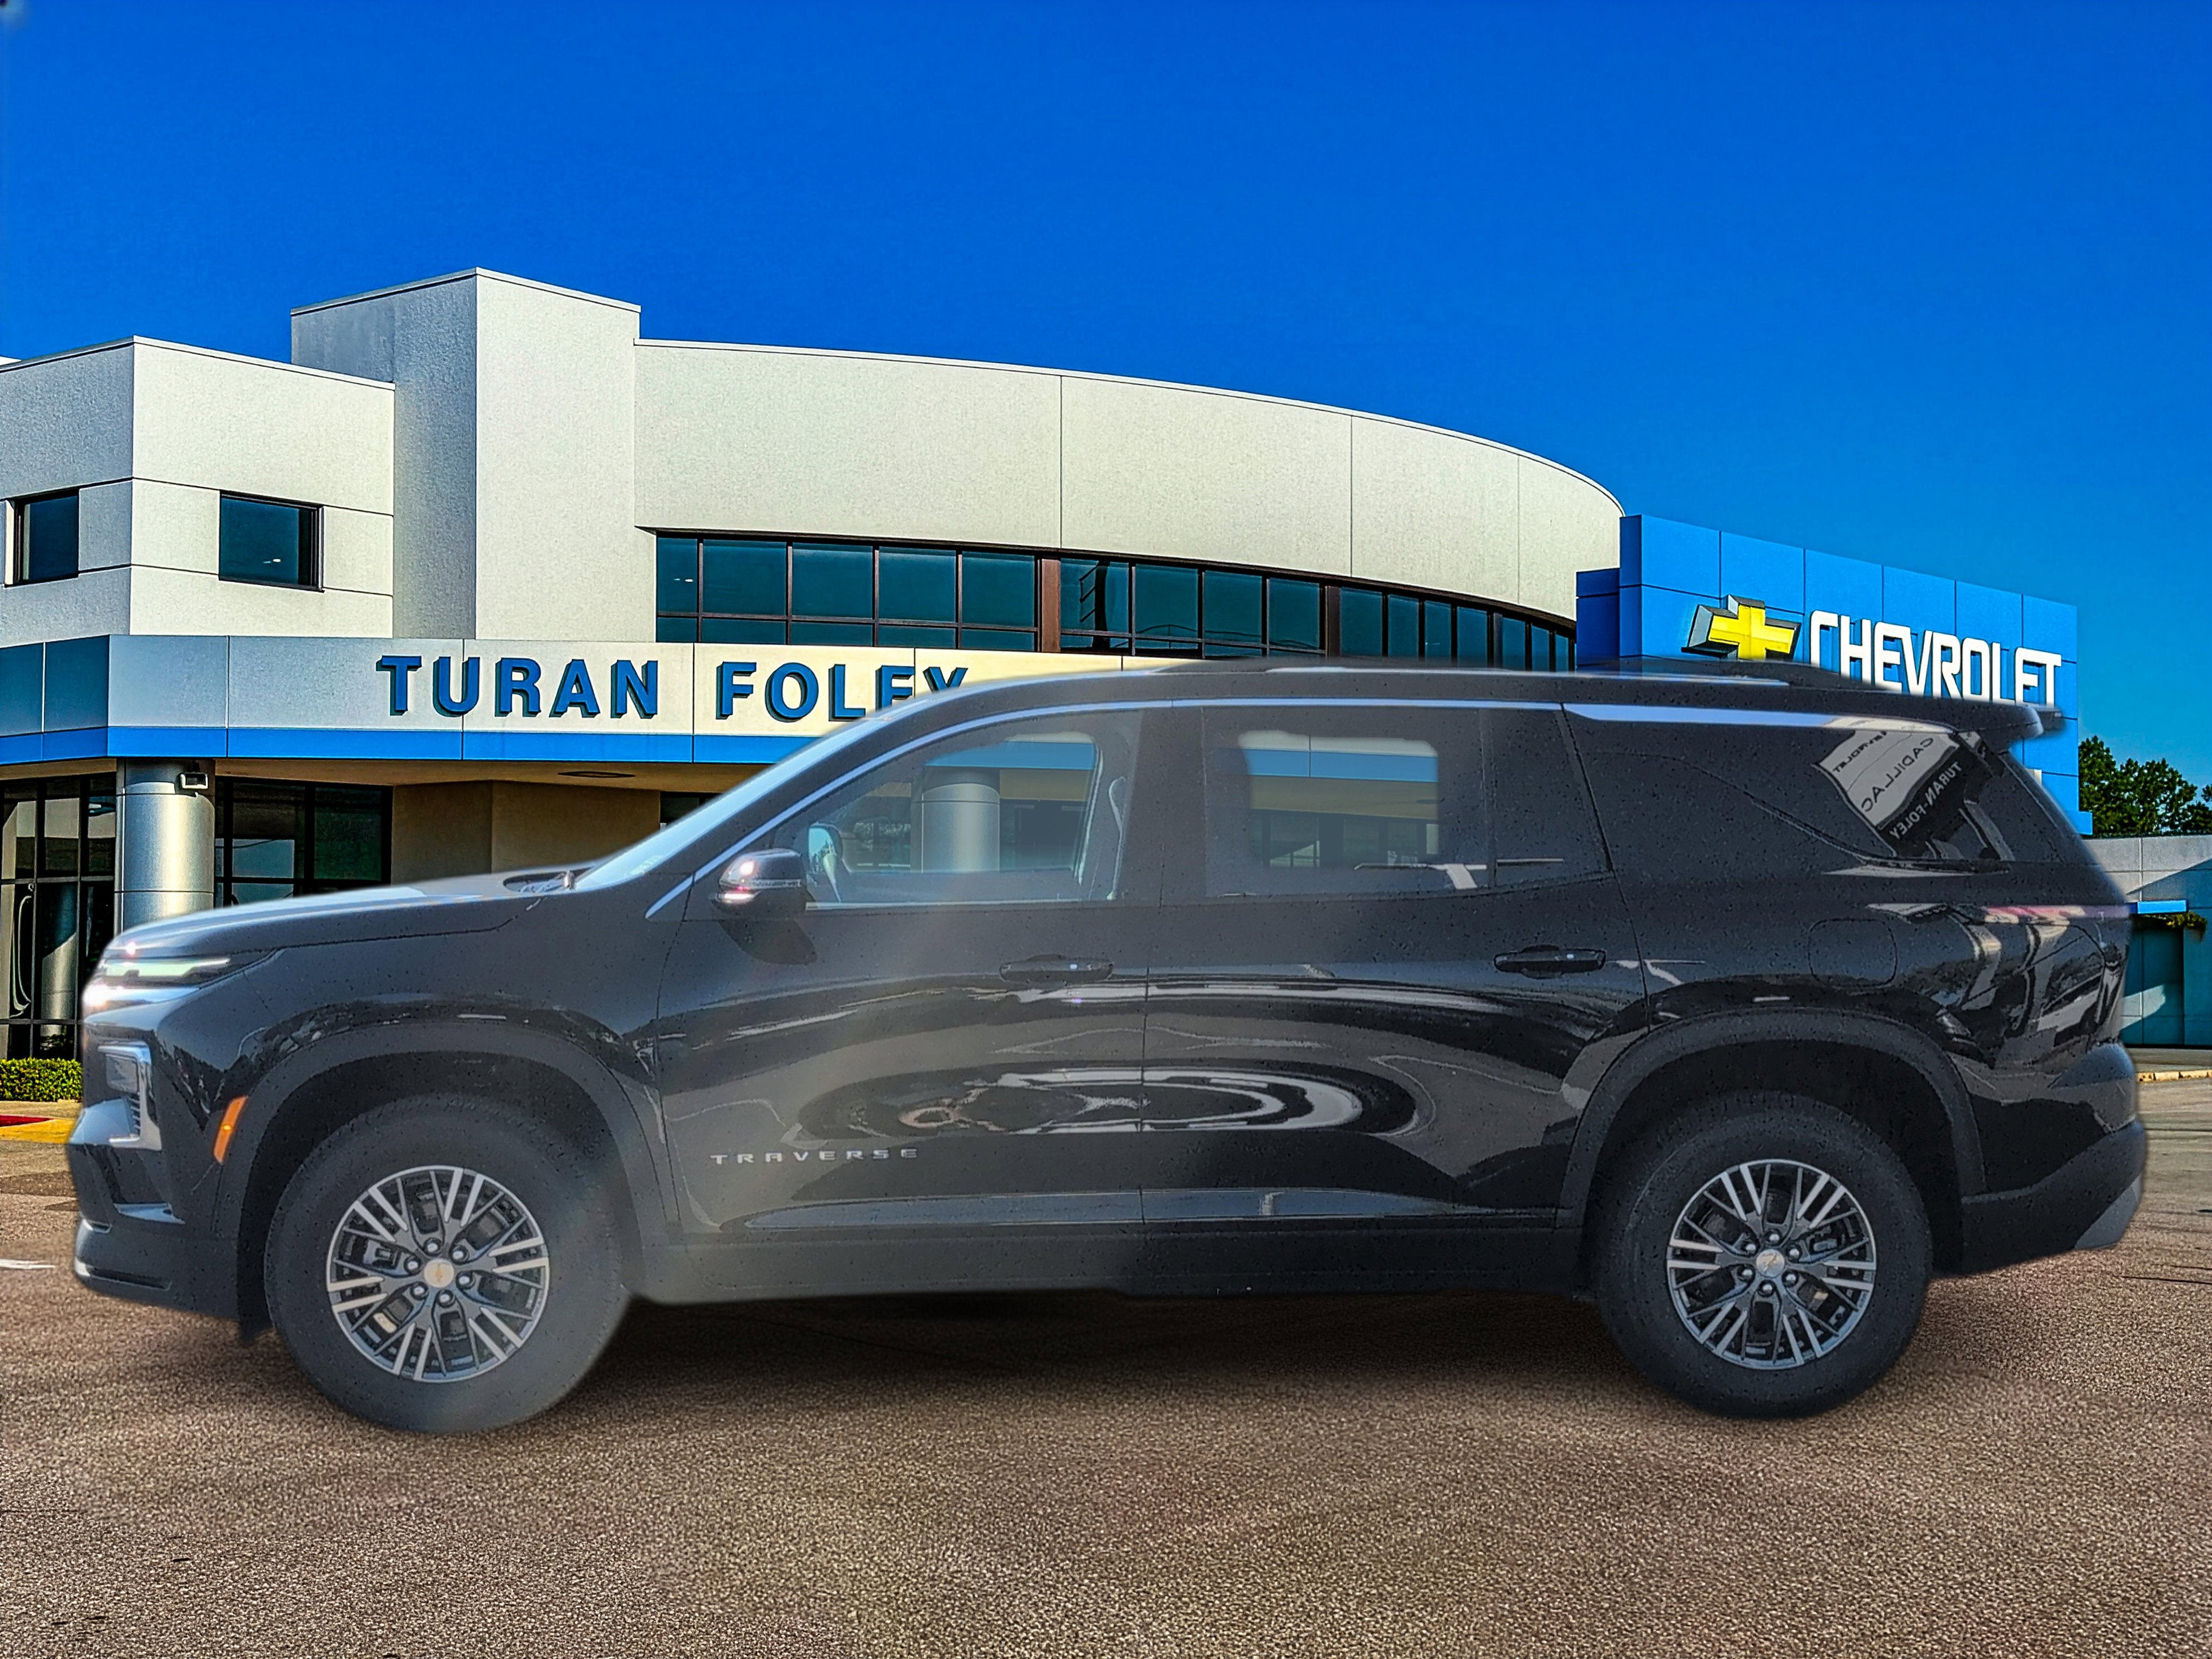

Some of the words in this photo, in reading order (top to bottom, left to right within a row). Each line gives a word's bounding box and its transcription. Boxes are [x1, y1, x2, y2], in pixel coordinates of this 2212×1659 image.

[376, 655, 658, 719] TURAN
[1810, 610, 2062, 707] CHEVROLET
[710, 1148, 918, 1165] TRAVERSE
